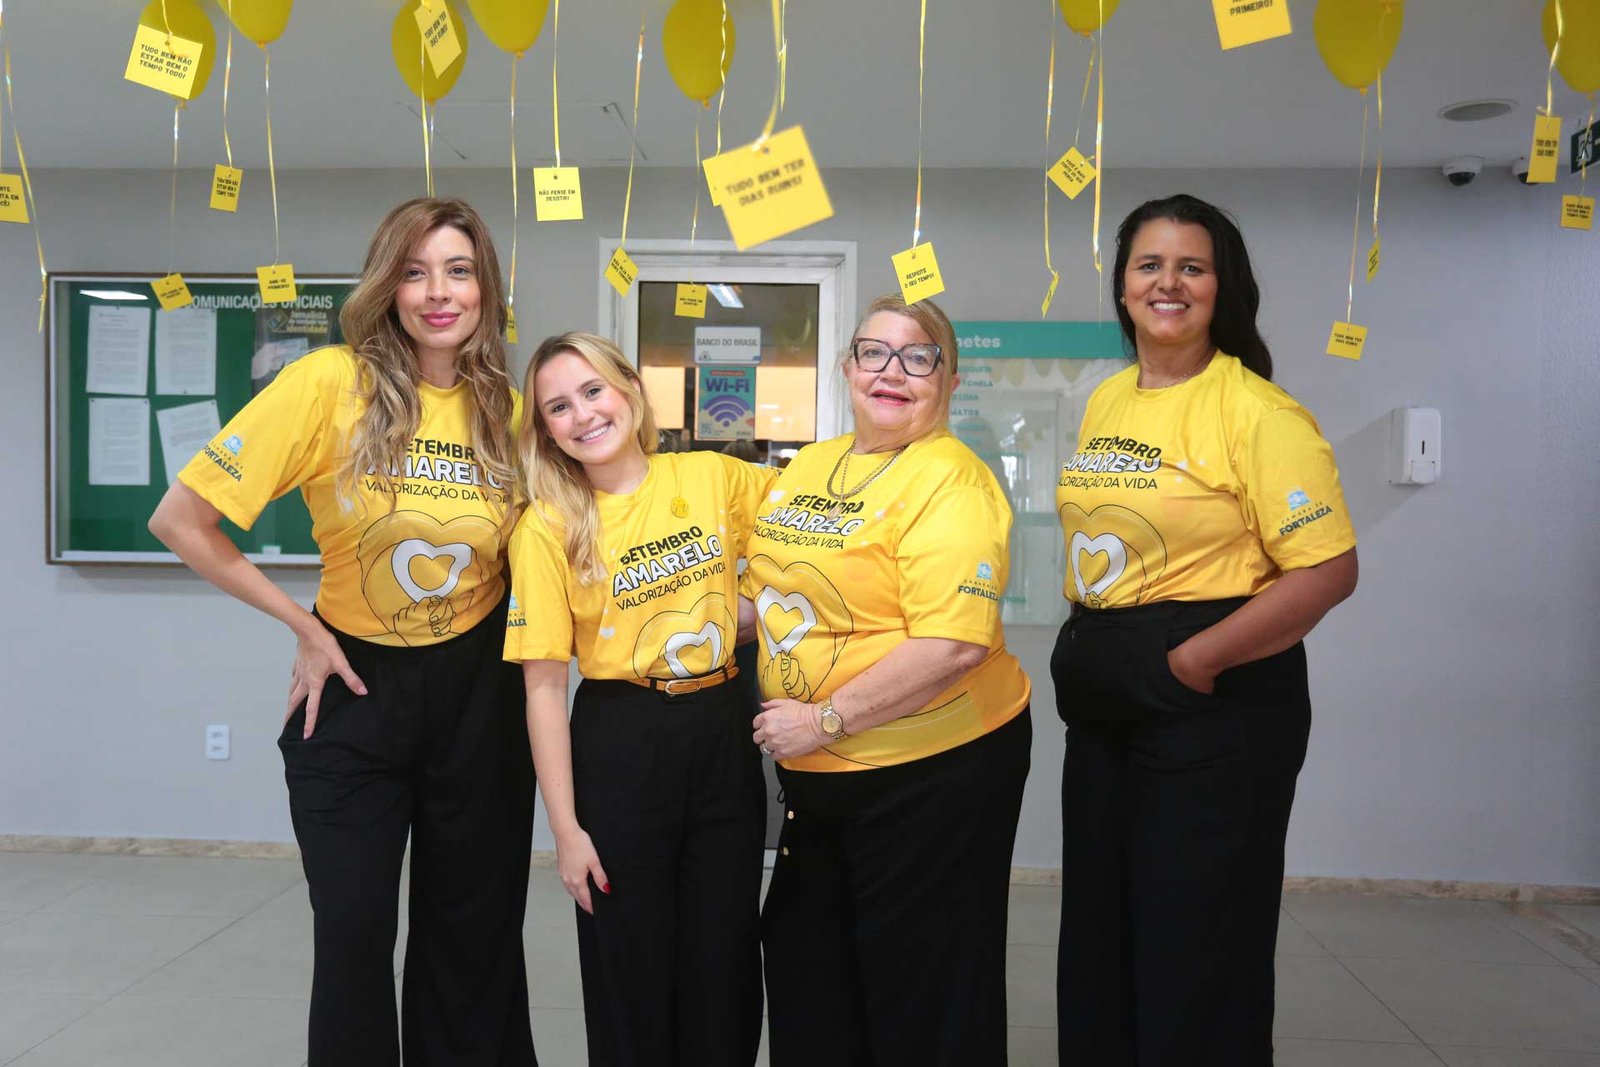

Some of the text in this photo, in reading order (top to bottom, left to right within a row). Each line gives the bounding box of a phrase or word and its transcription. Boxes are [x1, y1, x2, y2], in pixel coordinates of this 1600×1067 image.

[1229, 0, 1273, 16] PRIMEIRO!
[140, 52, 164, 64] ESTAR
[166, 61, 181, 70] BEM
[141, 43, 192, 66] TUDO BEM NÃO
[140, 59, 186, 79] TEMPO TODO!
[725, 158, 805, 195] TUDO BEM TER
[739, 175, 803, 207] DIAS RUINS!
[906, 267, 927, 280] RESPEITE
[918, 272, 934, 283] TEMPO!
[187, 292, 277, 312] OMUNICAÇÕ
[696, 338, 758, 346] BANCO DO BRASIL
[956, 334, 1001, 348] netes
[705, 378, 750, 393] Wi-Fi
[407, 438, 476, 461] ETEMBR
[1085, 435, 1162, 459] SETEMBRO
[203, 444, 242, 482] FORTALEZA
[365, 455, 505, 490] MARELO
[461, 489, 480, 501] DA
[1104, 478, 1120, 488] DA
[1121, 478, 1158, 489] VIDA
[758, 506, 865, 537] AMARELO
[1279, 505, 1333, 536] FORTALEZA
[620, 526, 703, 566] SETEMBRO
[753, 523, 844, 550] ALORIZAÇÃO DA VIDA
[613, 534, 723, 598] AMARELO
[616, 575, 692, 611] VALORIZAÇÃO
[692, 568, 709, 582] DA
